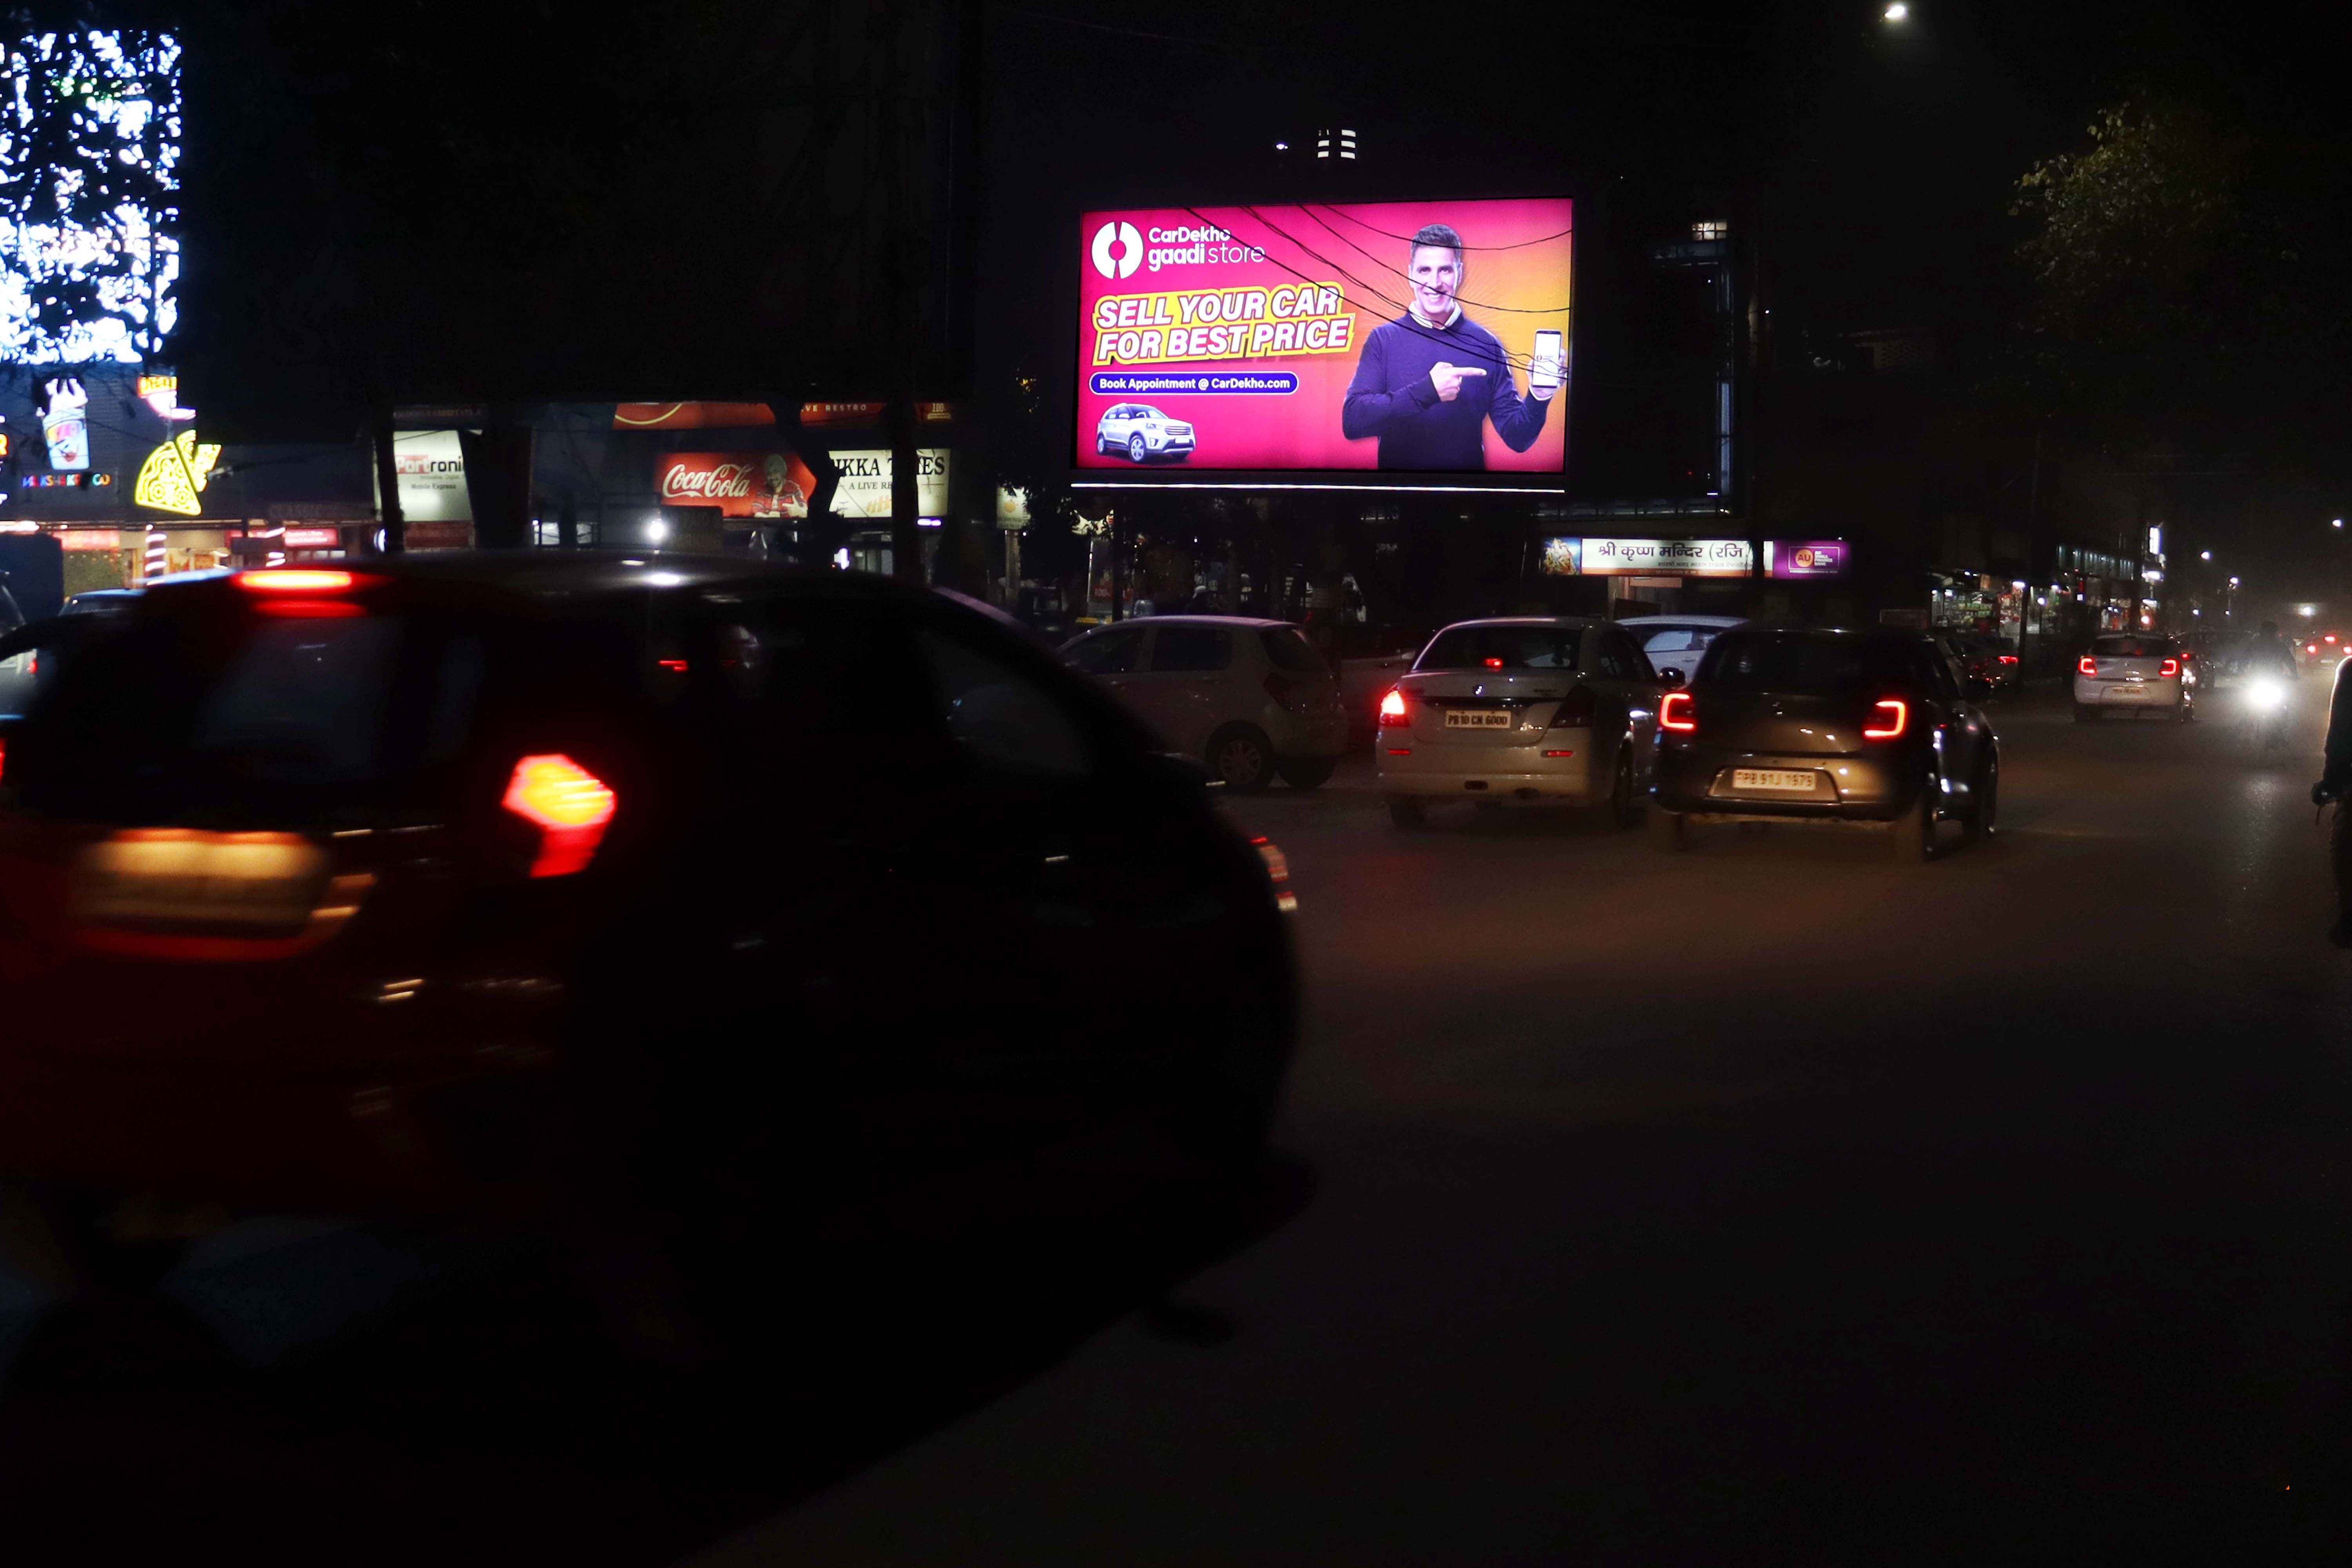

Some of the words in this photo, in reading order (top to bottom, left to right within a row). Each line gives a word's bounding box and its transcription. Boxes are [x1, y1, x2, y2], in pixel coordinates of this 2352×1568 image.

[1149, 226, 1230, 243] CarDekho
[1148, 243, 1205, 272] gaadi
[1207, 243, 1265, 263] store
[1098, 296, 1172, 328] SELL
[1179, 291, 1266, 324] YOUR
[1271, 287, 1340, 318] CAR
[1098, 329, 1162, 361] FOR
[1167, 325, 1249, 358] BEST
[1252, 318, 1350, 352] PRICE
[1100, 377, 1126, 389] Book
[1128, 377, 1196, 391] Appointment
[1198, 379, 1209, 390] @
[1211, 377, 1290, 389] CarDekho.com
[662, 464, 750, 497] Coca-Cola
[1599, 541, 1616, 556] श्री
[1620, 546, 1655, 561] कृष्ण
[1659, 543, 1704, 557] मन्दिर
[1448, 715, 1459, 725] PB
[1471, 715, 1483, 725] CN
